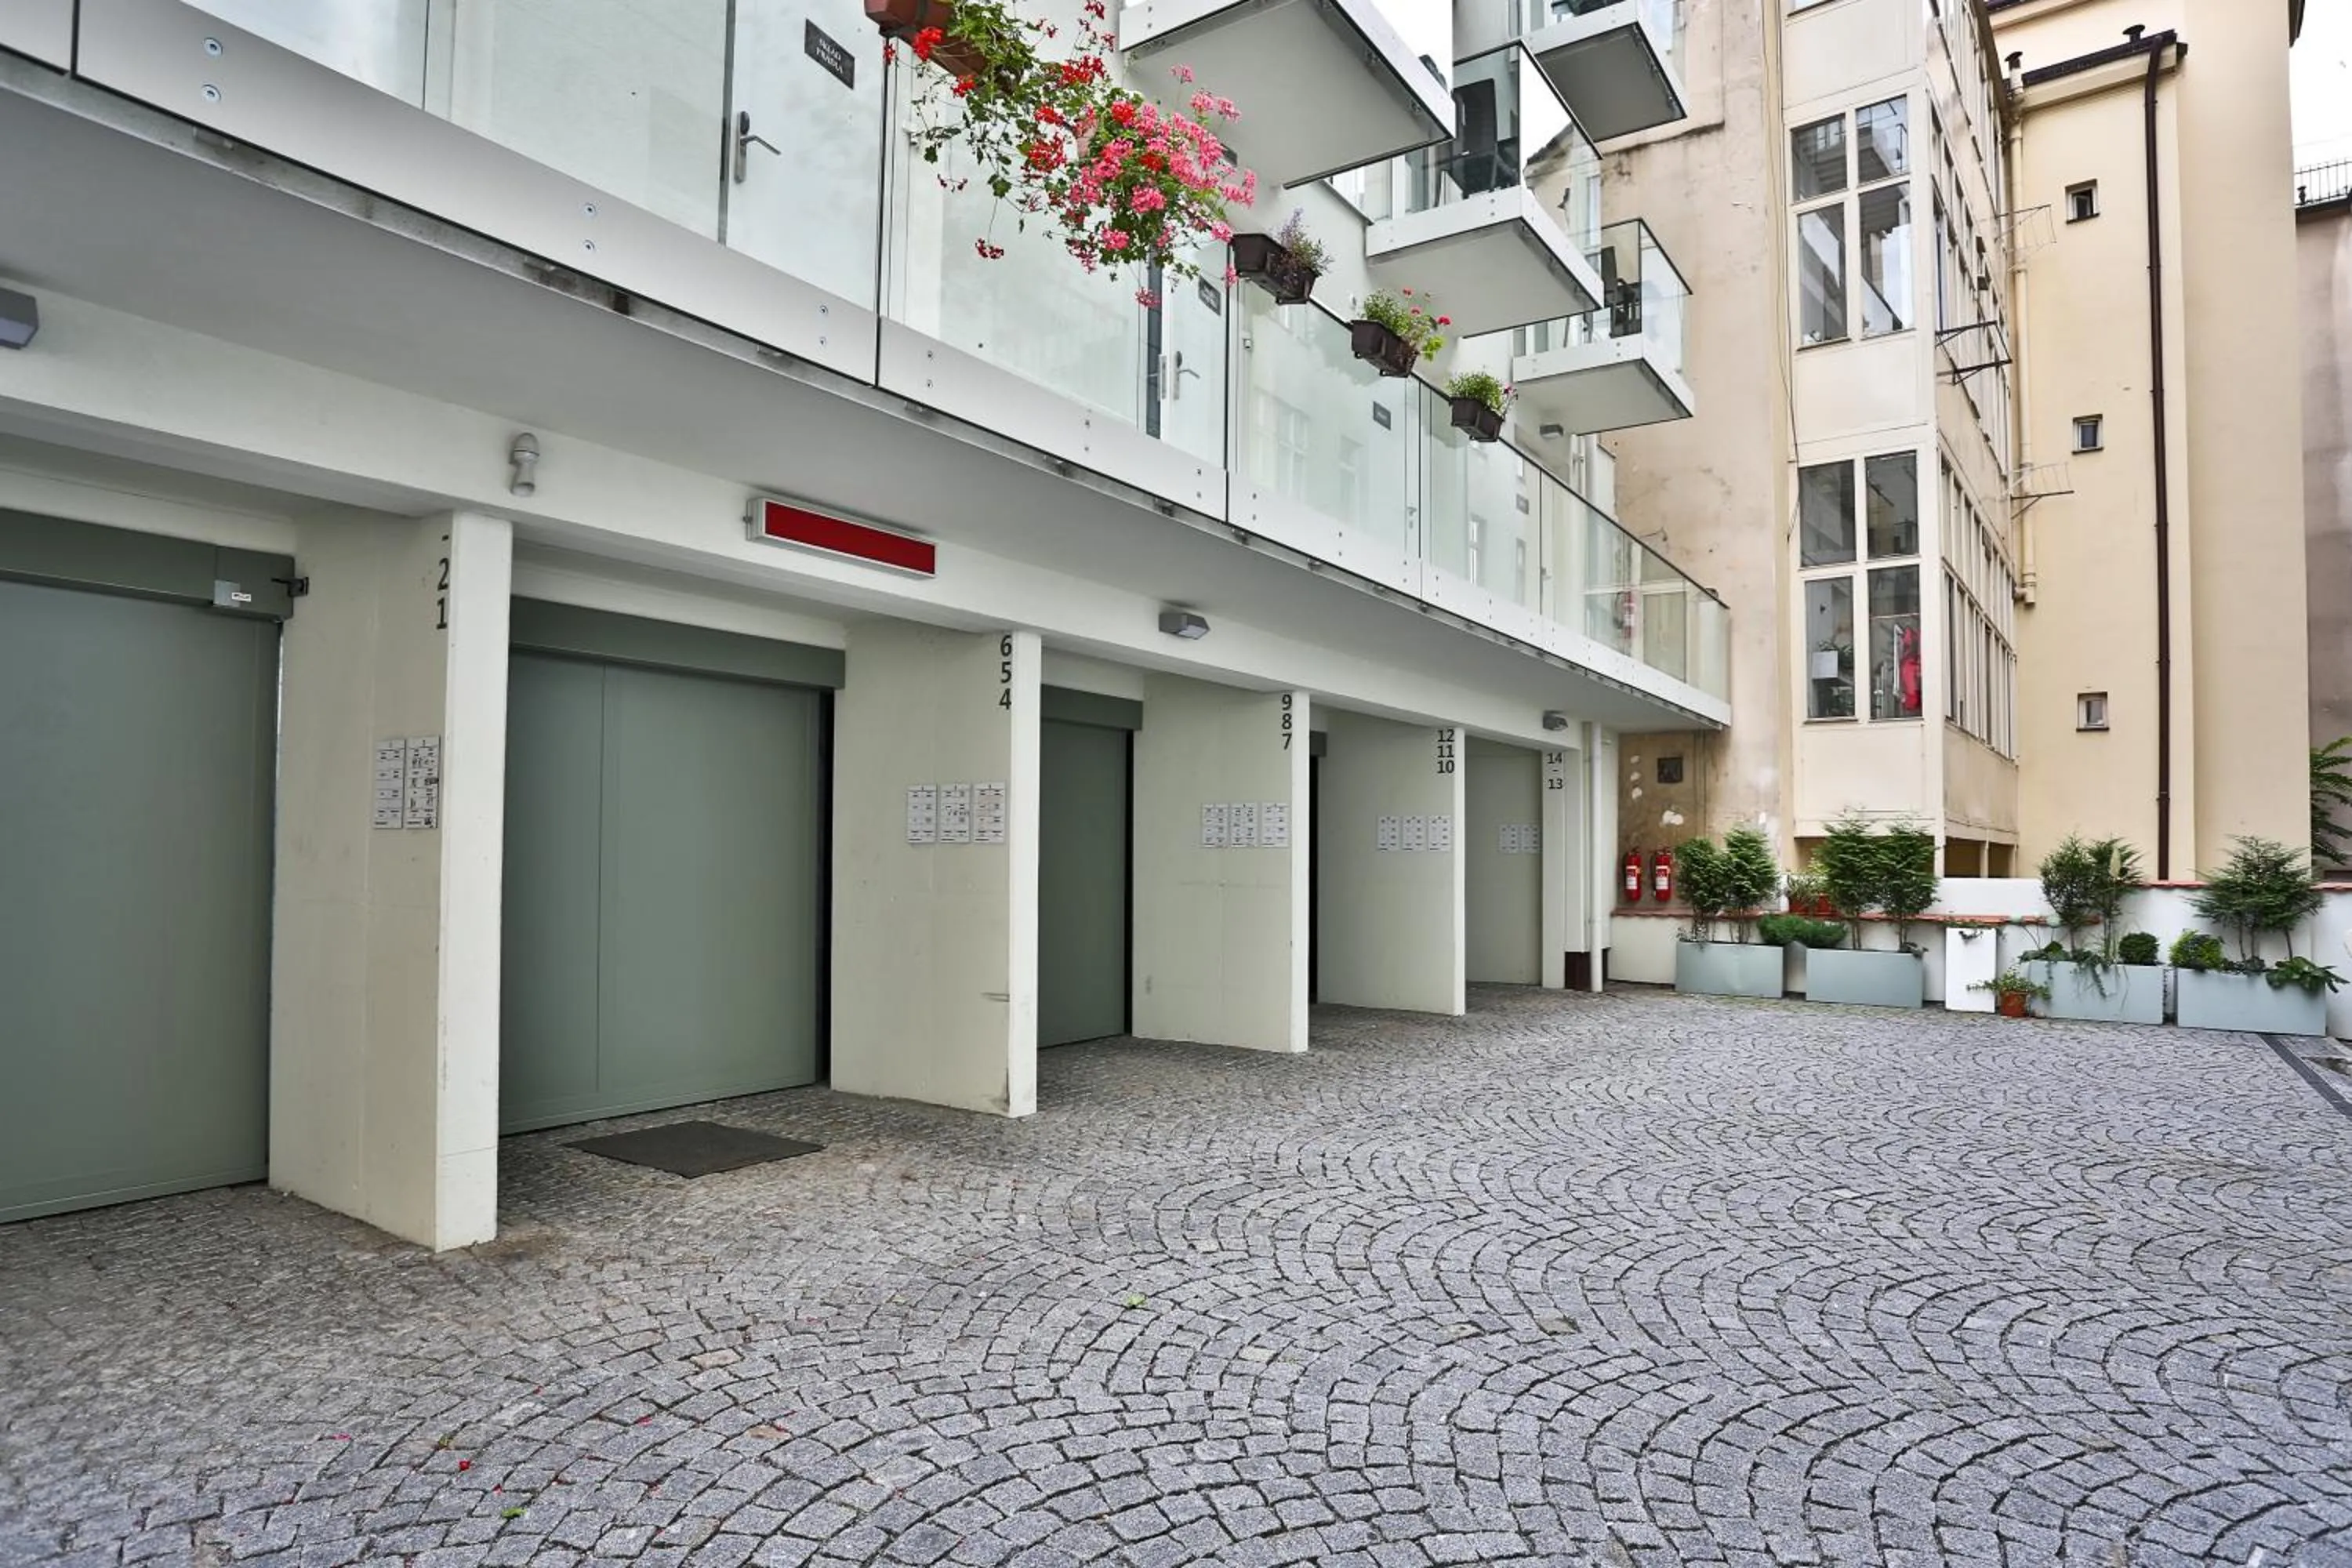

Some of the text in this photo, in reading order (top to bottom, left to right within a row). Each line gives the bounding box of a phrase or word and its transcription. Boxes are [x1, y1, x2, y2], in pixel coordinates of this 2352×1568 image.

[437, 557, 449, 590] 2
[437, 597, 448, 629] 1
[1000, 635, 1012, 656] 6
[1000, 661, 1012, 684] 5
[999, 688, 1012, 710] 4
[1282, 694, 1292, 710] 9
[1282, 713, 1292, 730] 8
[1282, 733, 1292, 750] 7
[1437, 729, 1455, 742] 12
[1437, 745, 1454, 758] 11
[1546, 752, 1563, 764] 14
[1437, 760, 1454, 774] 10
[1548, 779, 1563, 789] 13
